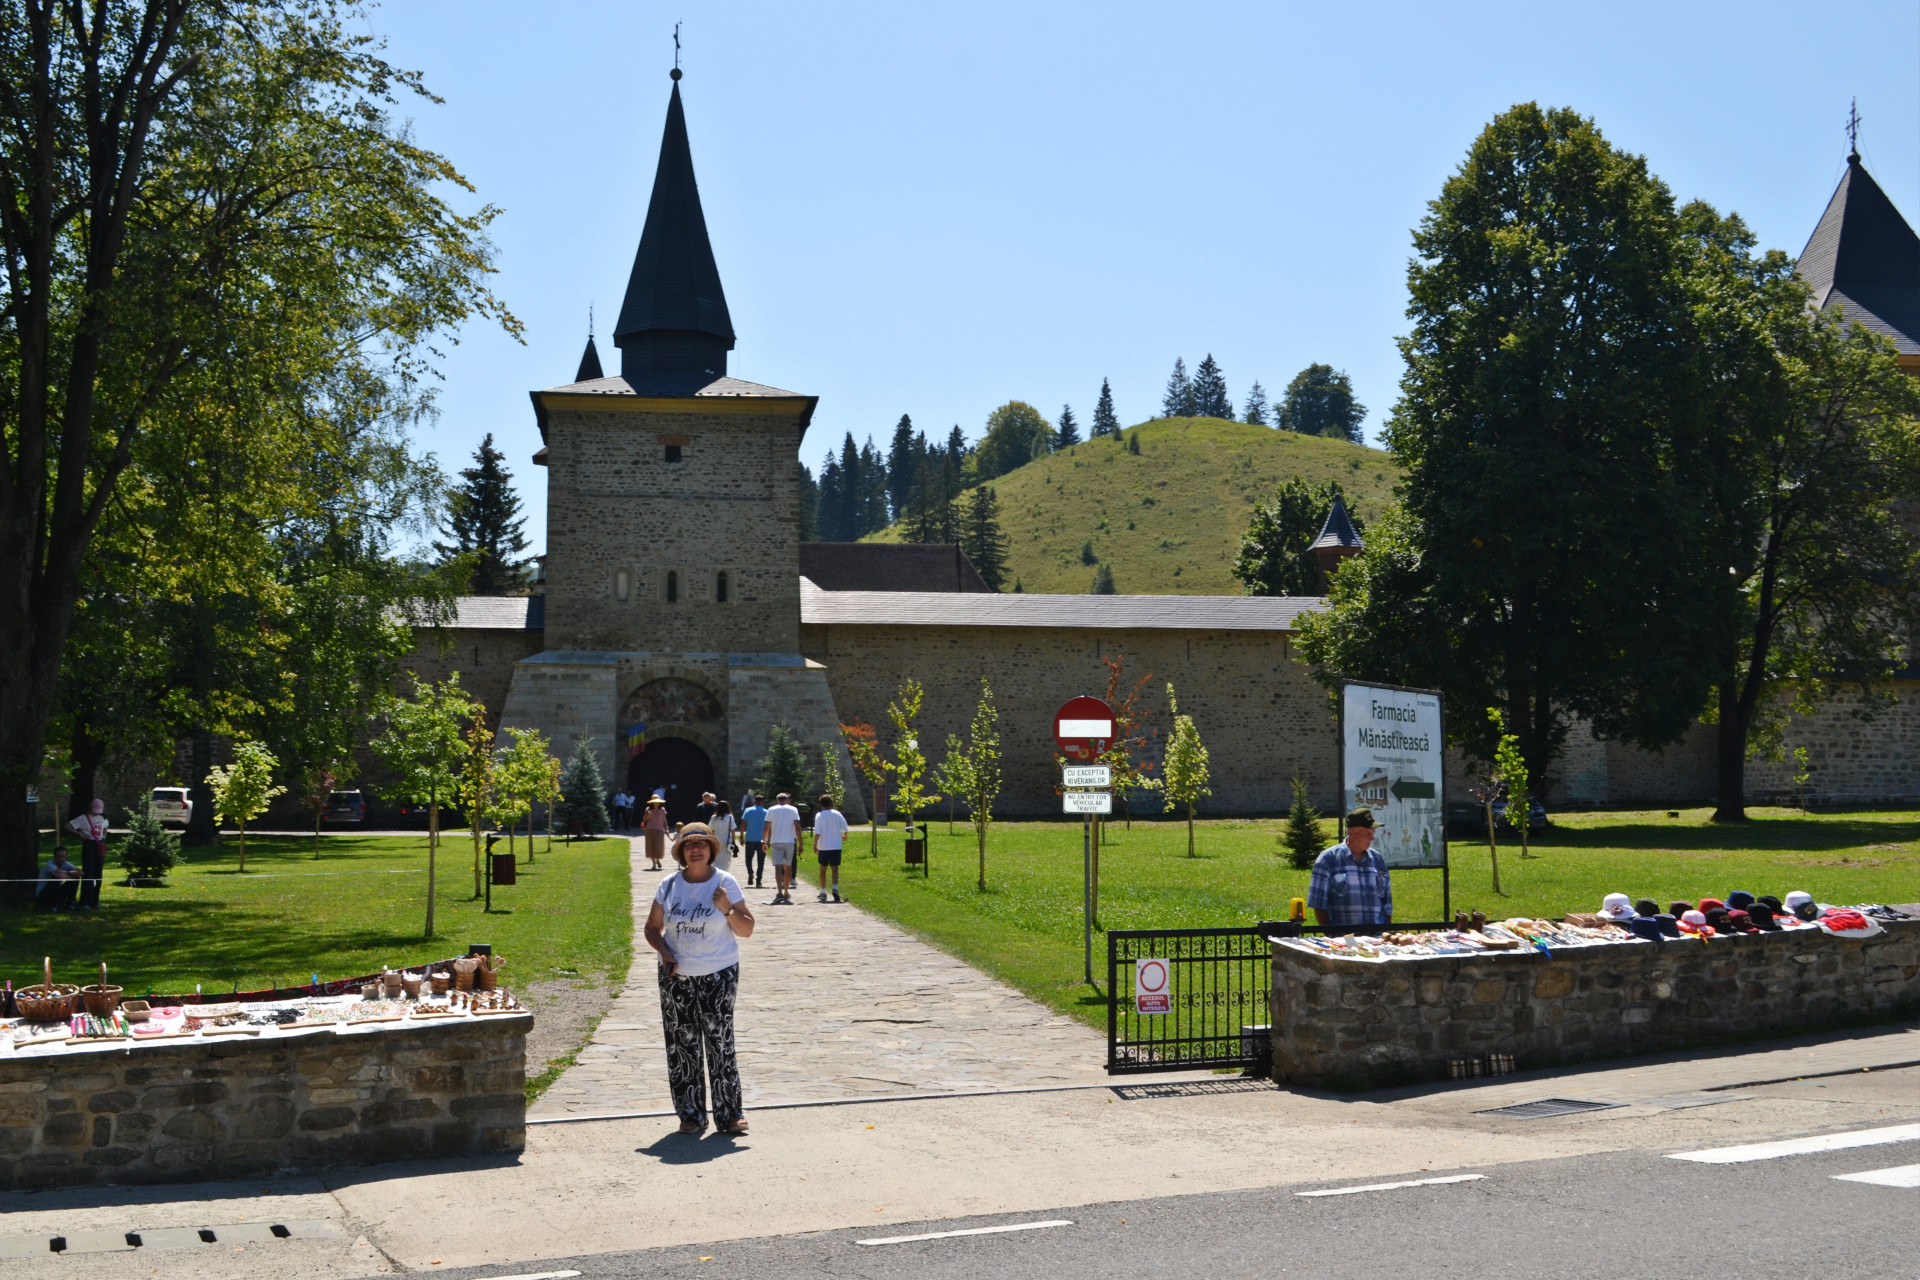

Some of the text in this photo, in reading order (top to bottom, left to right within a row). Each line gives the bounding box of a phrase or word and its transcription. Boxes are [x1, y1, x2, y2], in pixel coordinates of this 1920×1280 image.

[1371, 700, 1416, 723] Farmacia
[1358, 727, 1430, 752] Mănăstirească
[668, 902, 715, 922] You Are
[676, 921, 705, 938] Proud
